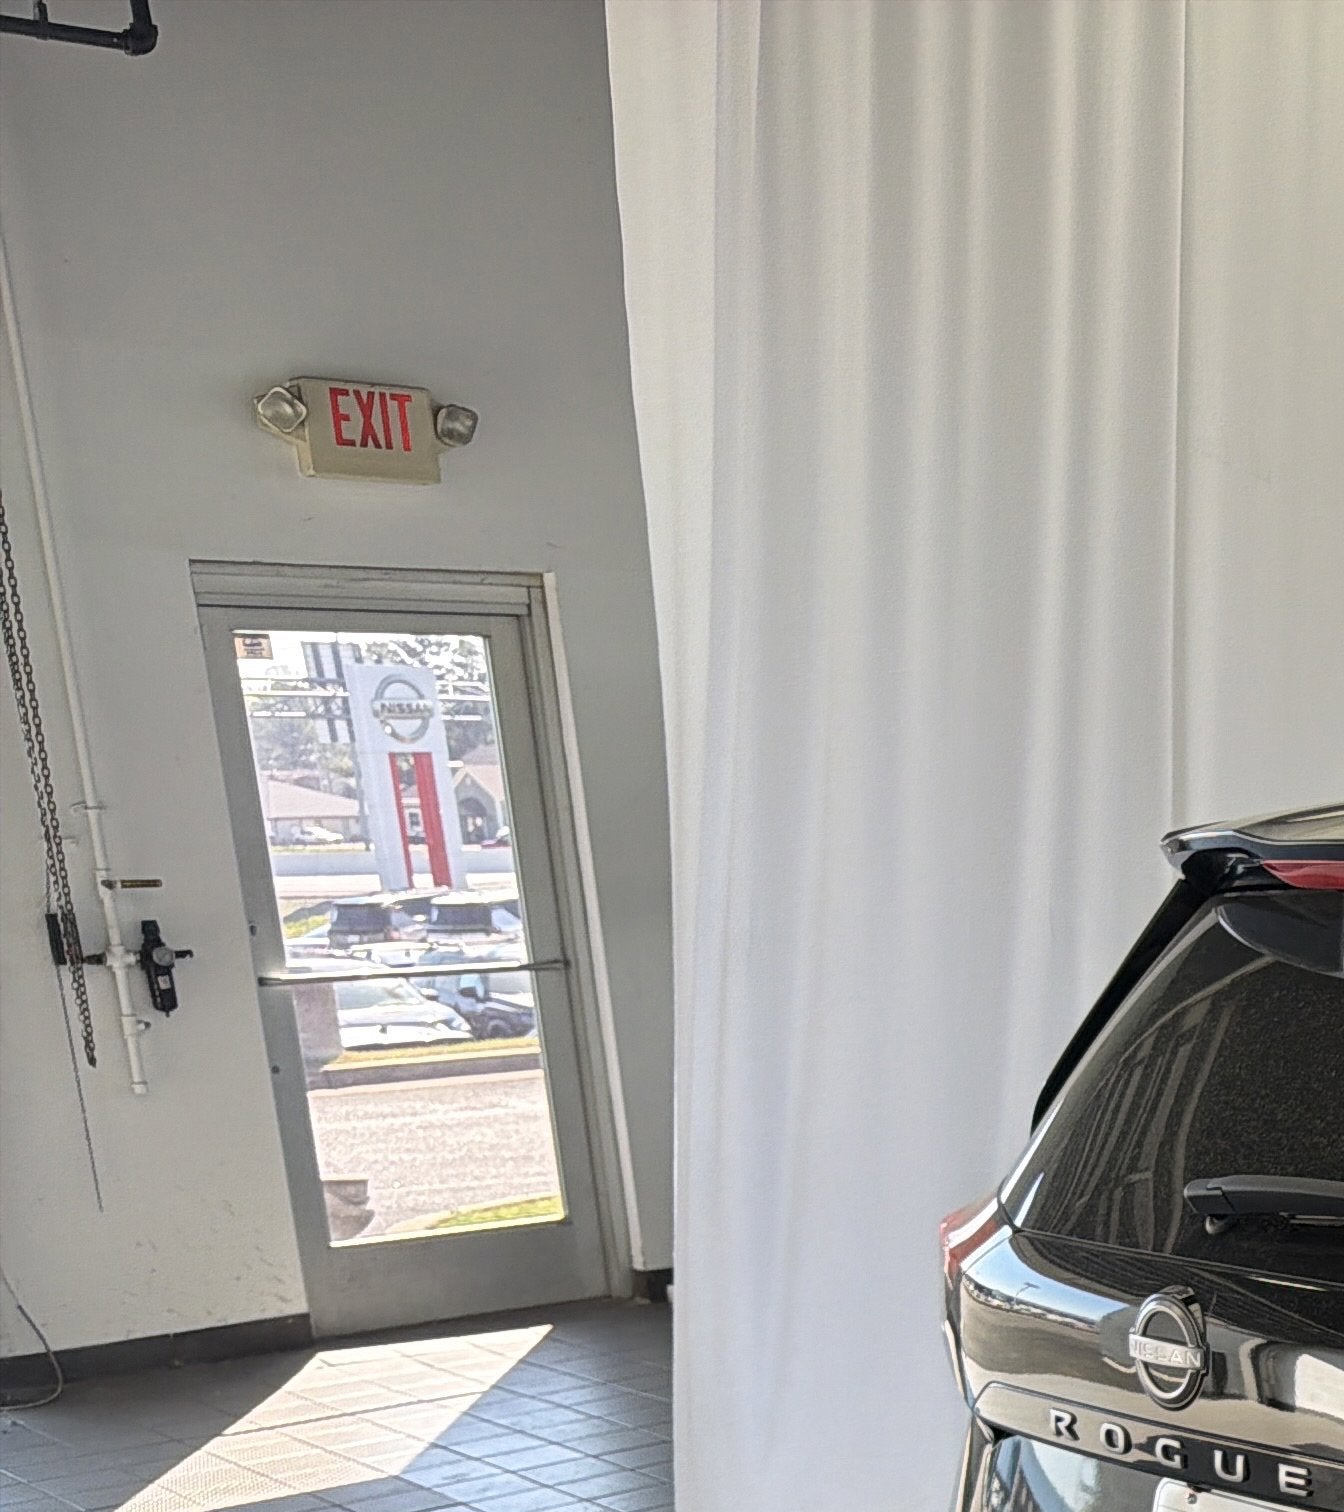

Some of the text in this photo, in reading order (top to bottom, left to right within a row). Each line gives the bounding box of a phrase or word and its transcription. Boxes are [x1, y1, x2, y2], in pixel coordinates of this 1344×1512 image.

[329, 386, 413, 452] EXIT
[373, 702, 433, 716] NISSAN
[1128, 1336, 1202, 1368] NISSAN
[1049, 1407, 1314, 1498] ROGUE
